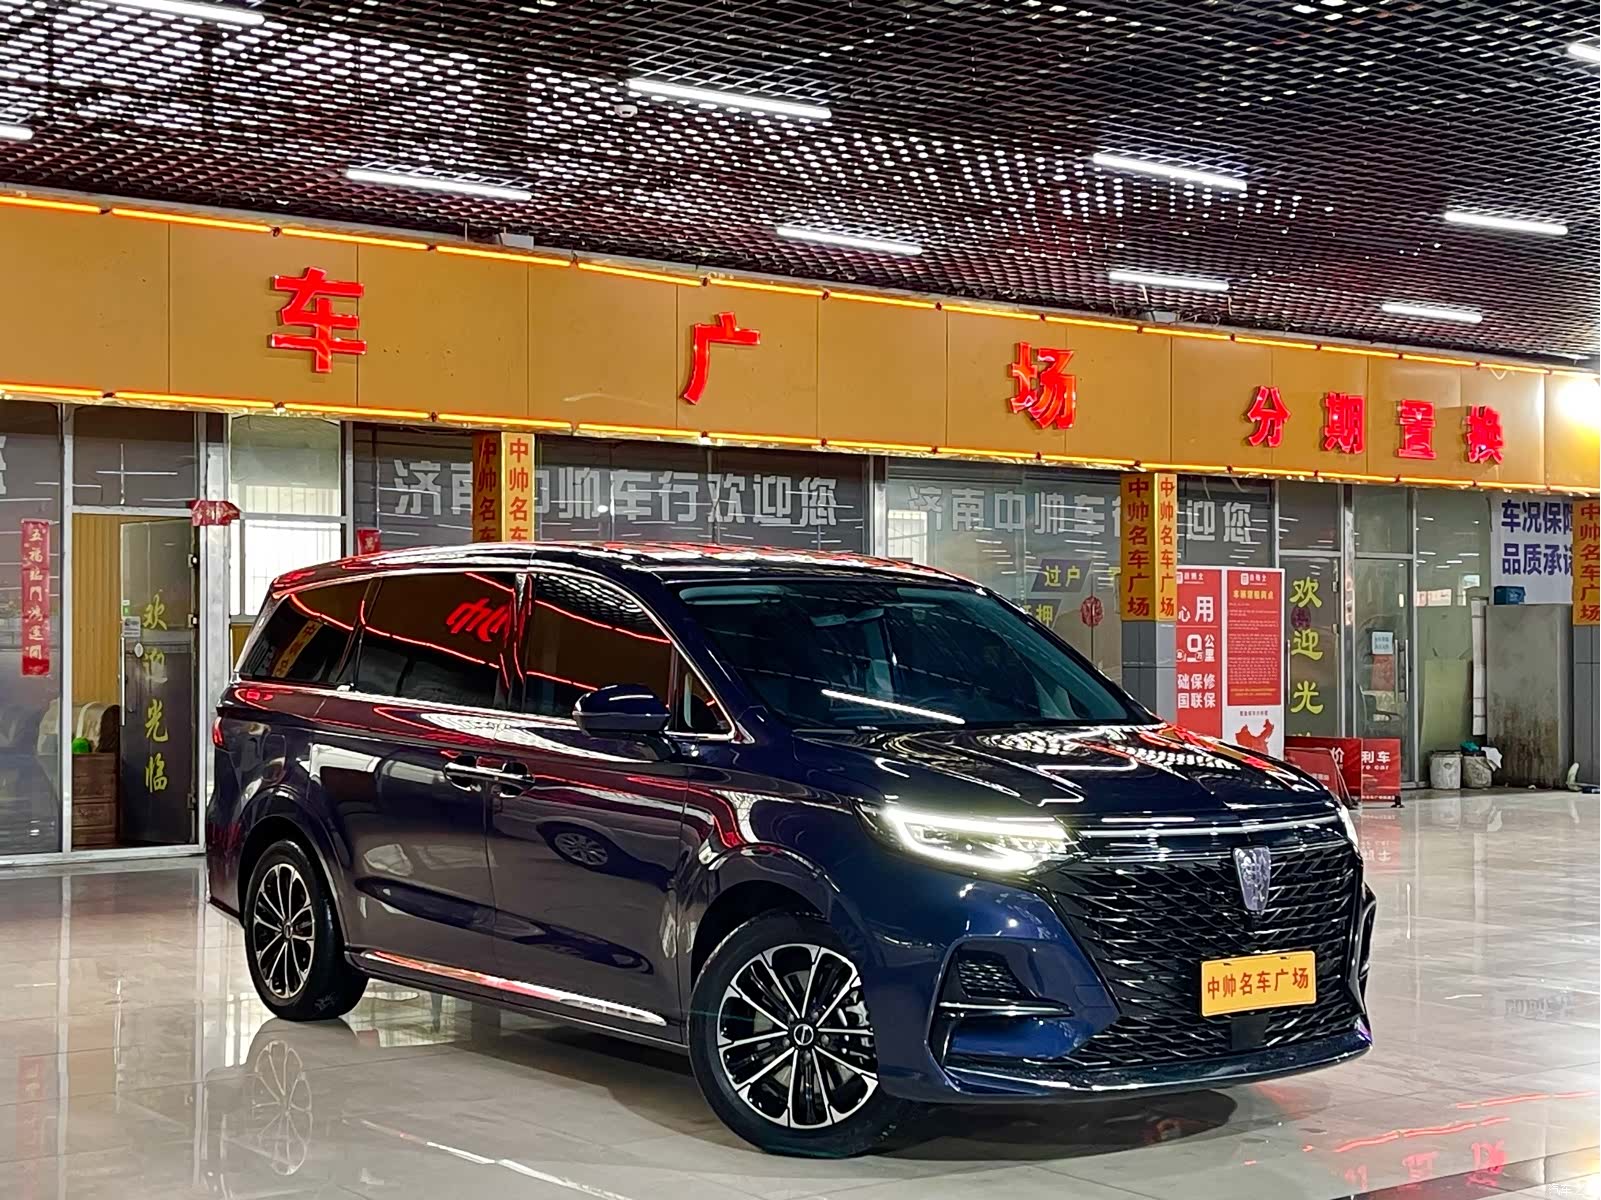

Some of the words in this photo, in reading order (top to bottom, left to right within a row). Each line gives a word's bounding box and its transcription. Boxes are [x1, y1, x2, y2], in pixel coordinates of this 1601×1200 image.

[1246, 385, 1505, 464] 分期置换
[1128, 478, 1150, 617] 中帅名车广场
[1160, 478, 1174, 617] 中帅名车广场
[1580, 503, 1600, 621] 中帅名车广场
[1044, 565, 1080, 587] 过户
[1178, 673, 1215, 690] 础保修
[1178, 692, 1215, 709] 国联保
[1207, 967, 1309, 1000] 中帅名车广场
